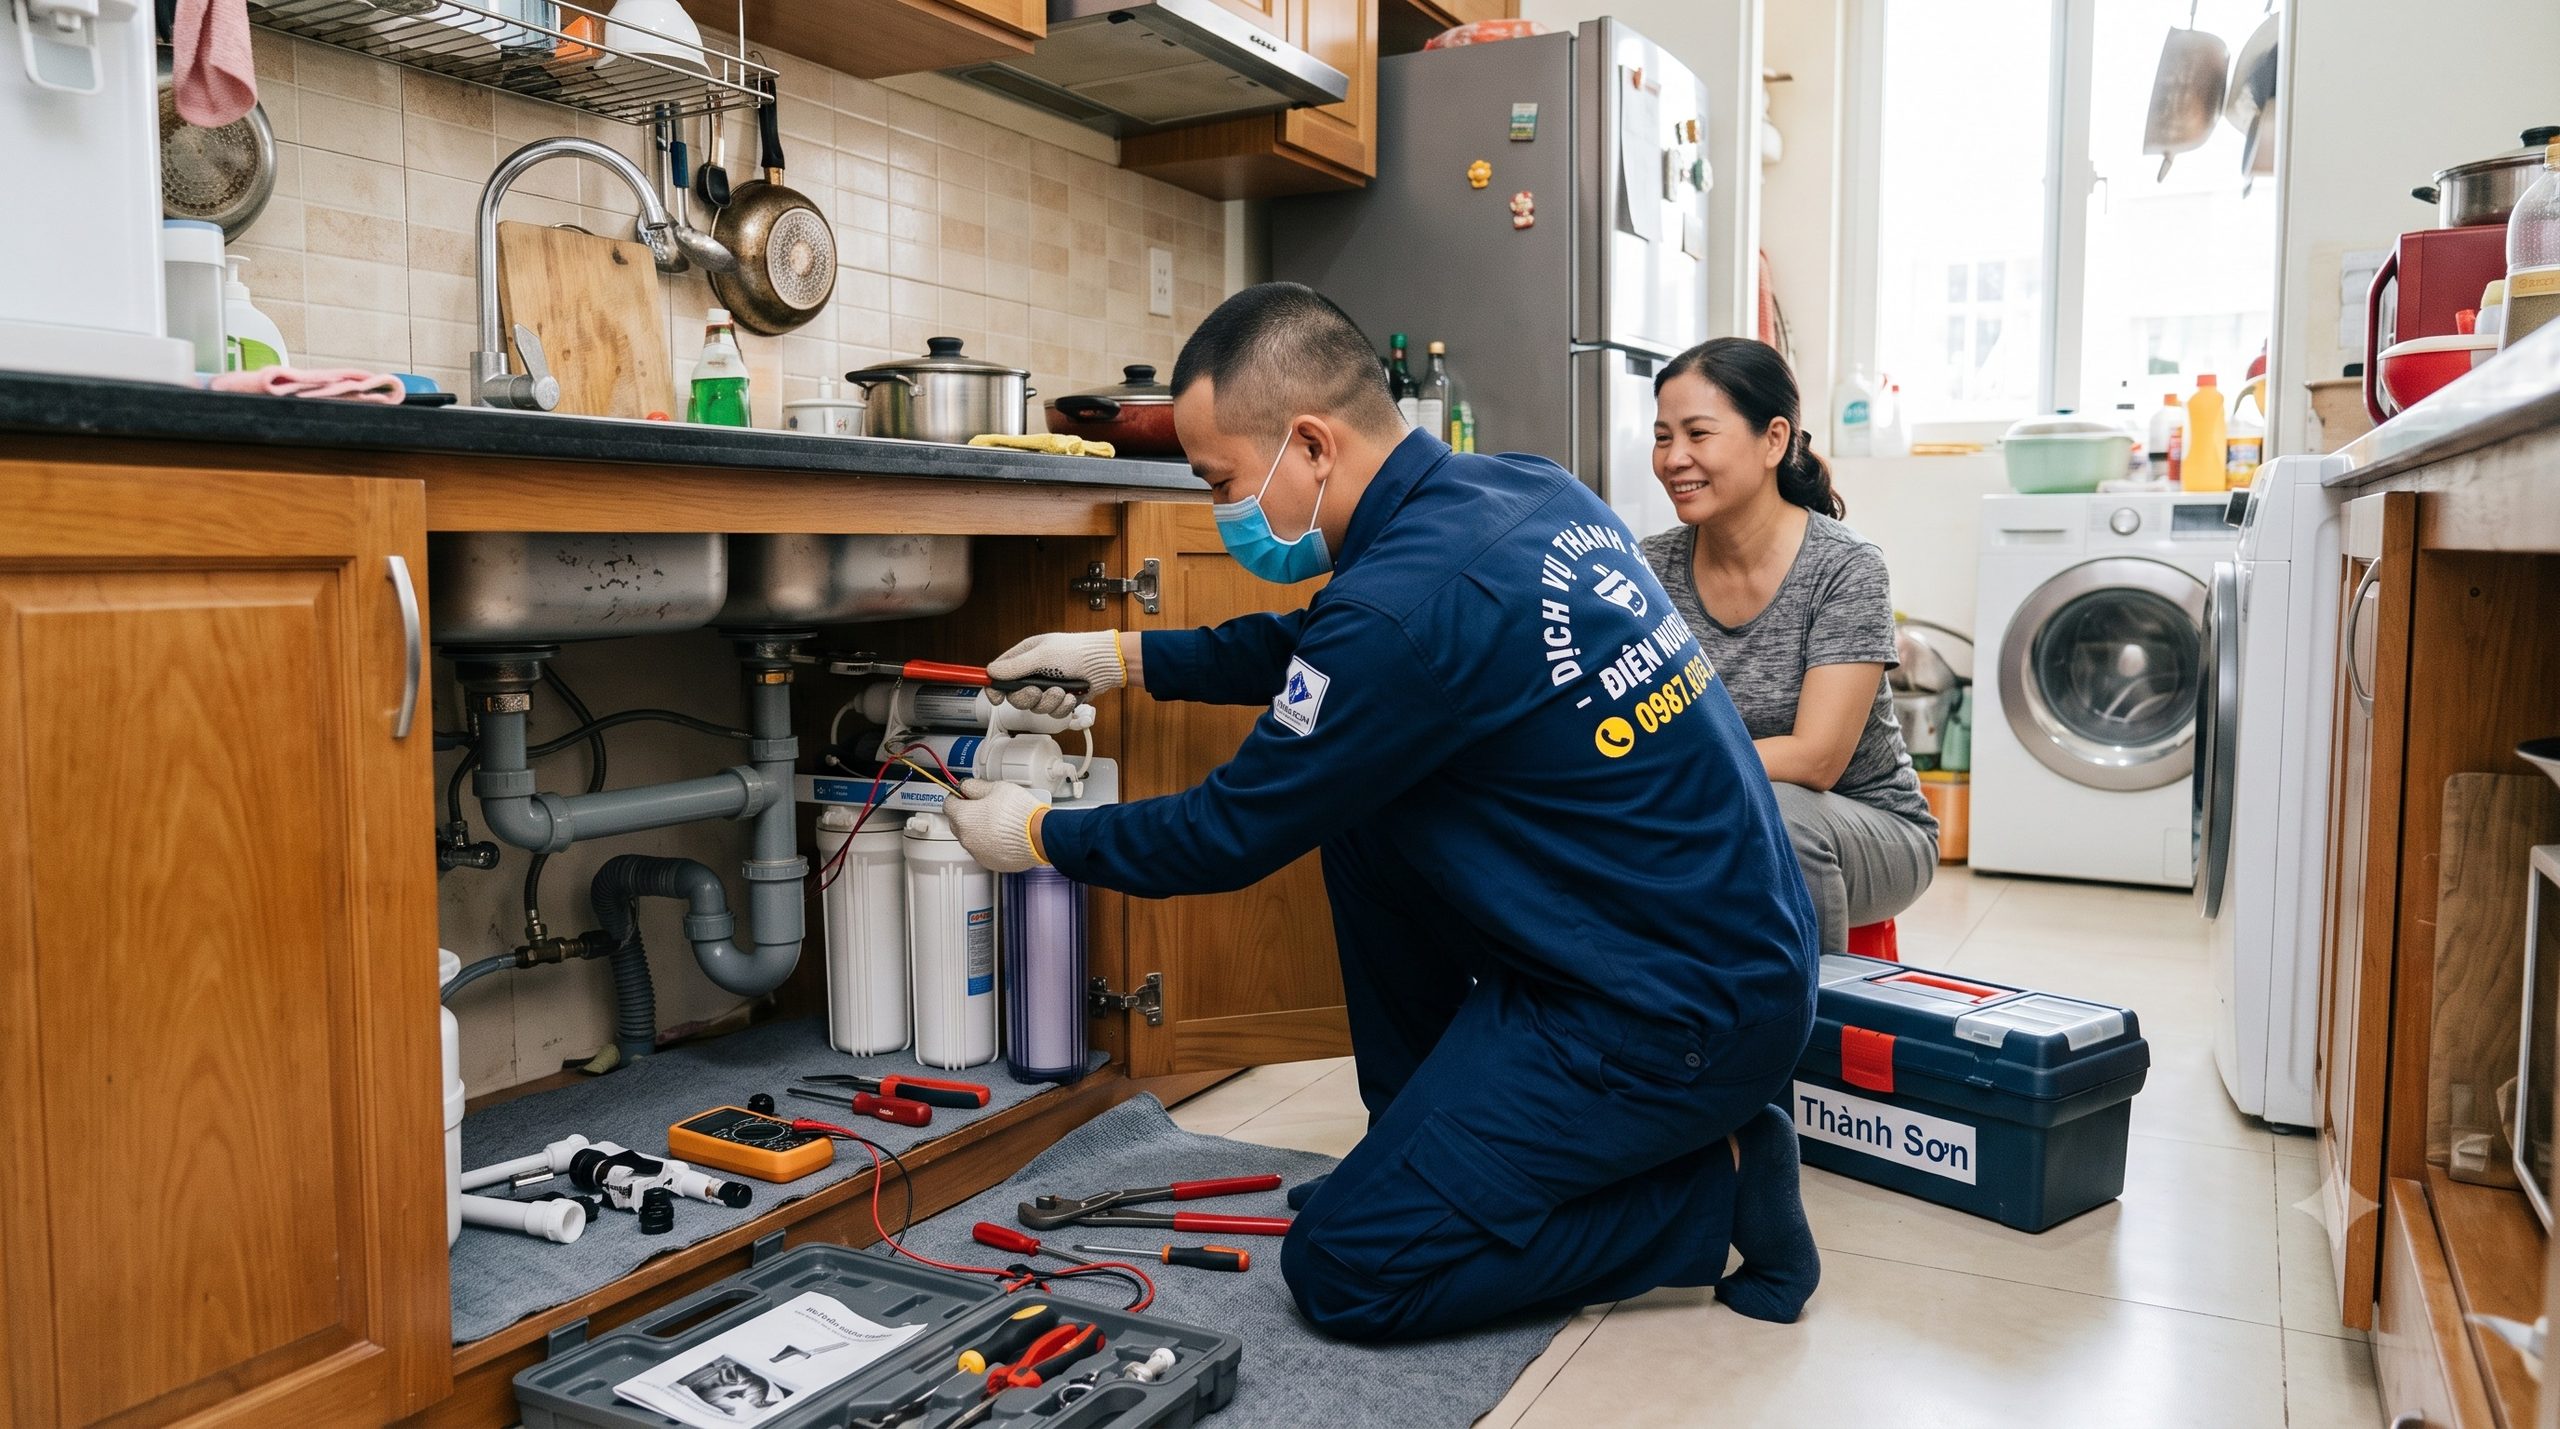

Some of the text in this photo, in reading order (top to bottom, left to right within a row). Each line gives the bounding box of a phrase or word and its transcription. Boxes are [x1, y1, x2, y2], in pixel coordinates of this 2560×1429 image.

[1541, 520, 1627, 687] DỊCH VỤ THÀNH
[1599, 637, 1663, 701] ĐIỆN
[1800, 1095, 1968, 1171] Thành Sơn
